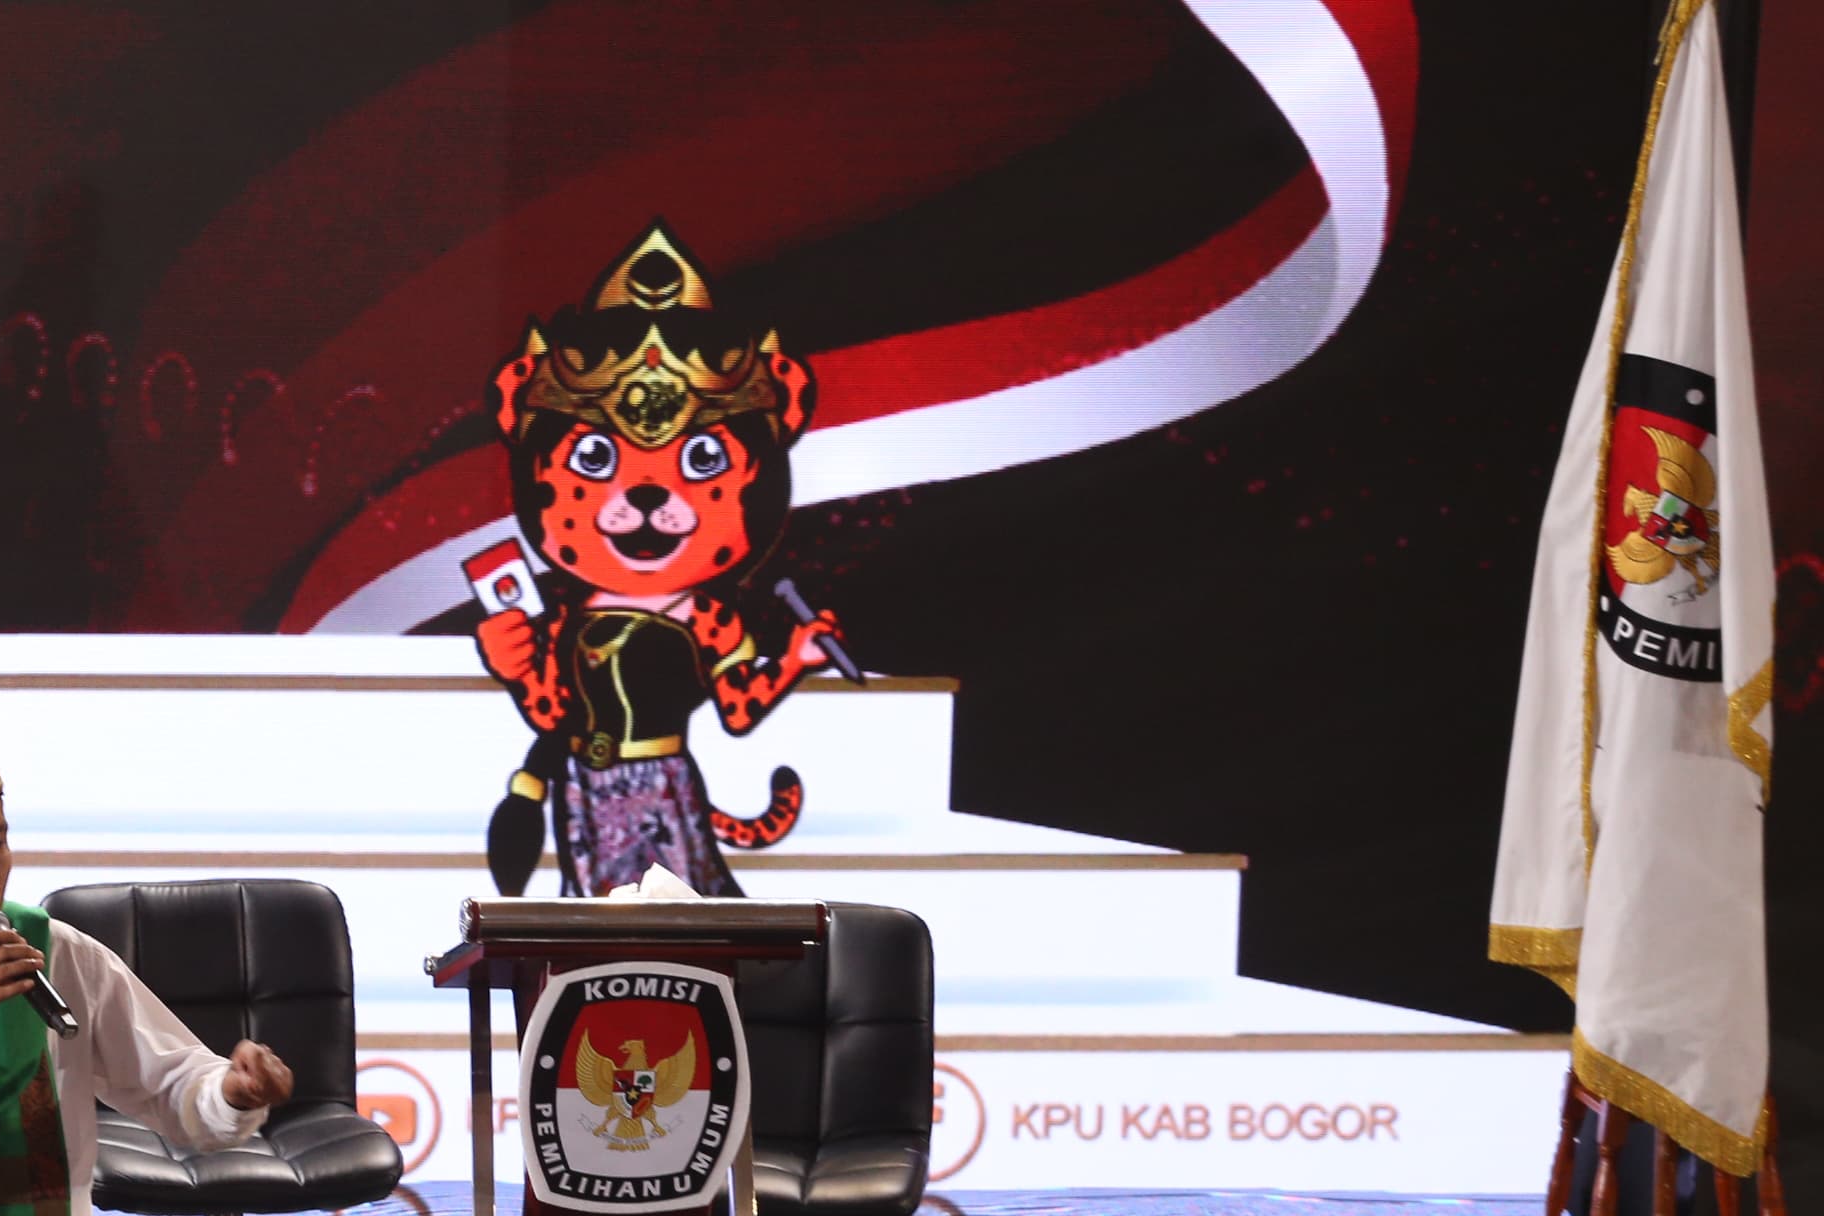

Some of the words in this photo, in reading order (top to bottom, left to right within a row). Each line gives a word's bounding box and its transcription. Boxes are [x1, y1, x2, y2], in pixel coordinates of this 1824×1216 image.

[1612, 616, 1717, 671] PEMI
[584, 977, 702, 1003] KOMISI
[1012, 1103, 1103, 1140] KPU
[1120, 1105, 1210, 1140] KAB
[1228, 1104, 1400, 1140] BOGOR
[535, 1103, 661, 1197] PEMILIHAN
[673, 1103, 731, 1194] UMUM
